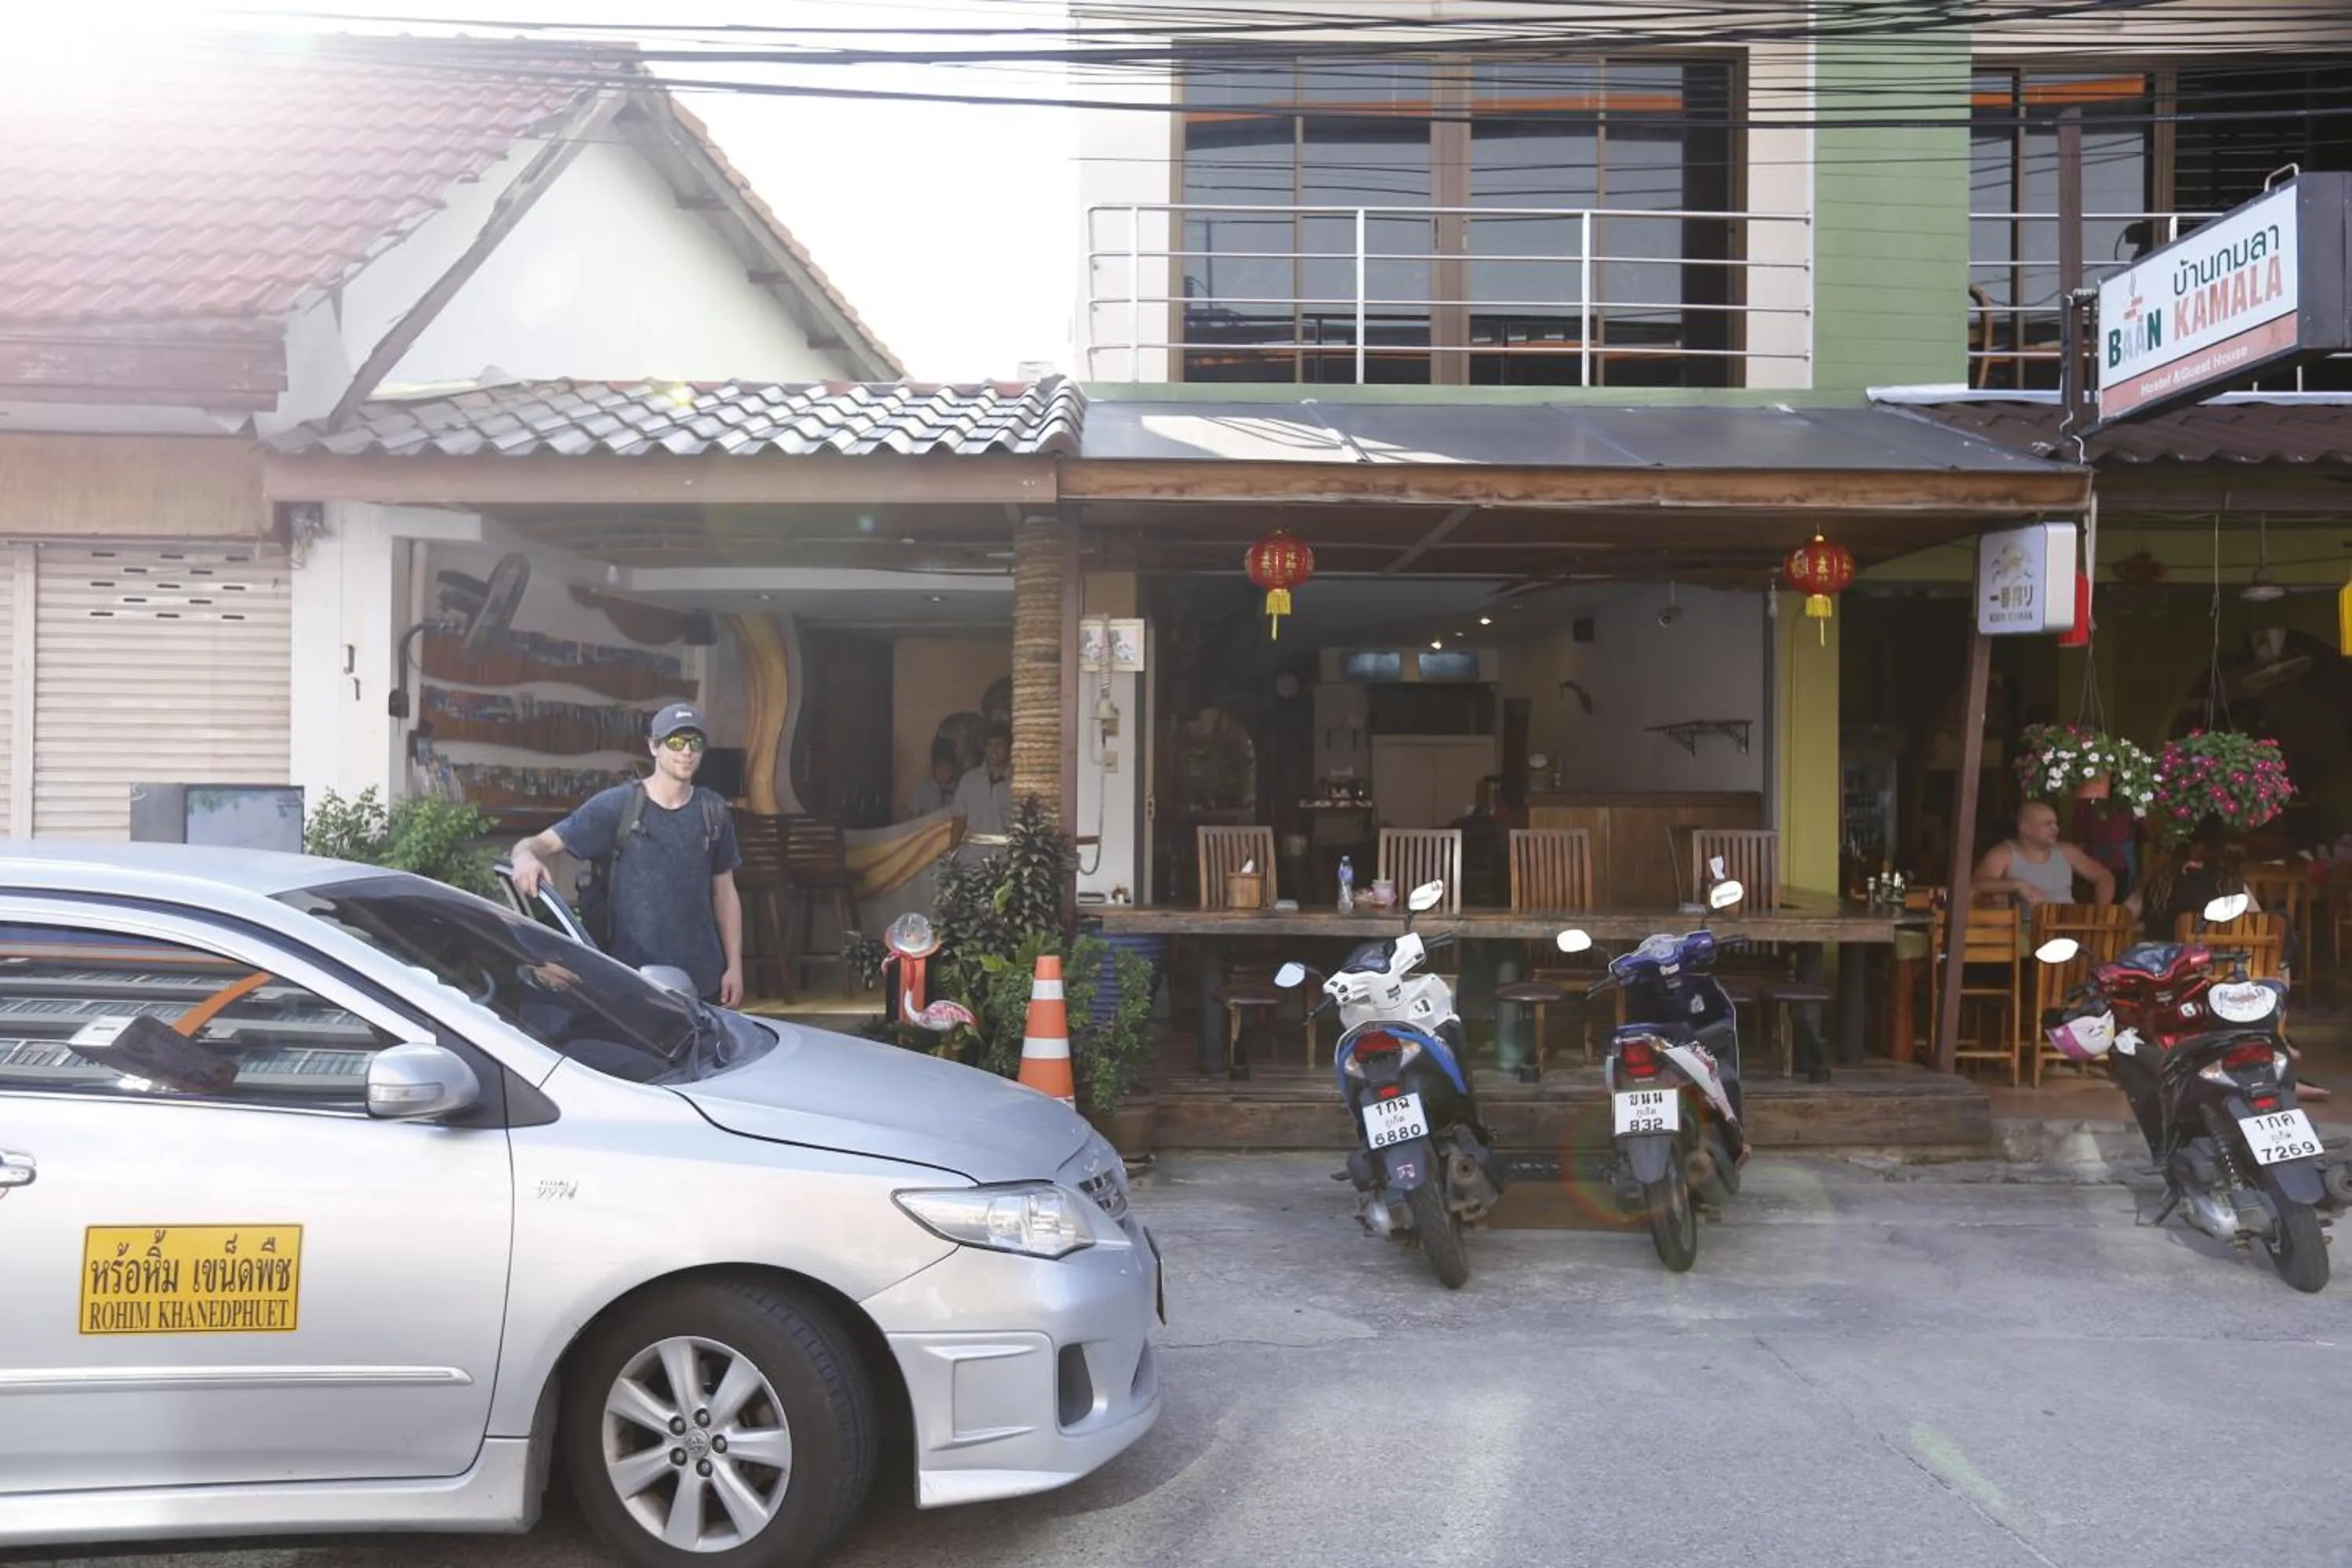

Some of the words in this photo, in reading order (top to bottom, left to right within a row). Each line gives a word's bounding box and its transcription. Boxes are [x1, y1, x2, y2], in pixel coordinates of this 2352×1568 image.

[2173, 223, 2280, 296] บ้านกมลา
[2108, 308, 2161, 368] BAAN
[2173, 255, 2283, 341] KAMALA
[1374, 1123, 1421, 1145] 6880
[1630, 1117, 1664, 1131] 832
[2260, 1141, 2315, 1161] 7269
[89, 1301, 151, 1330] ROHIM
[158, 1299, 289, 1329] KHANEDPHUET
